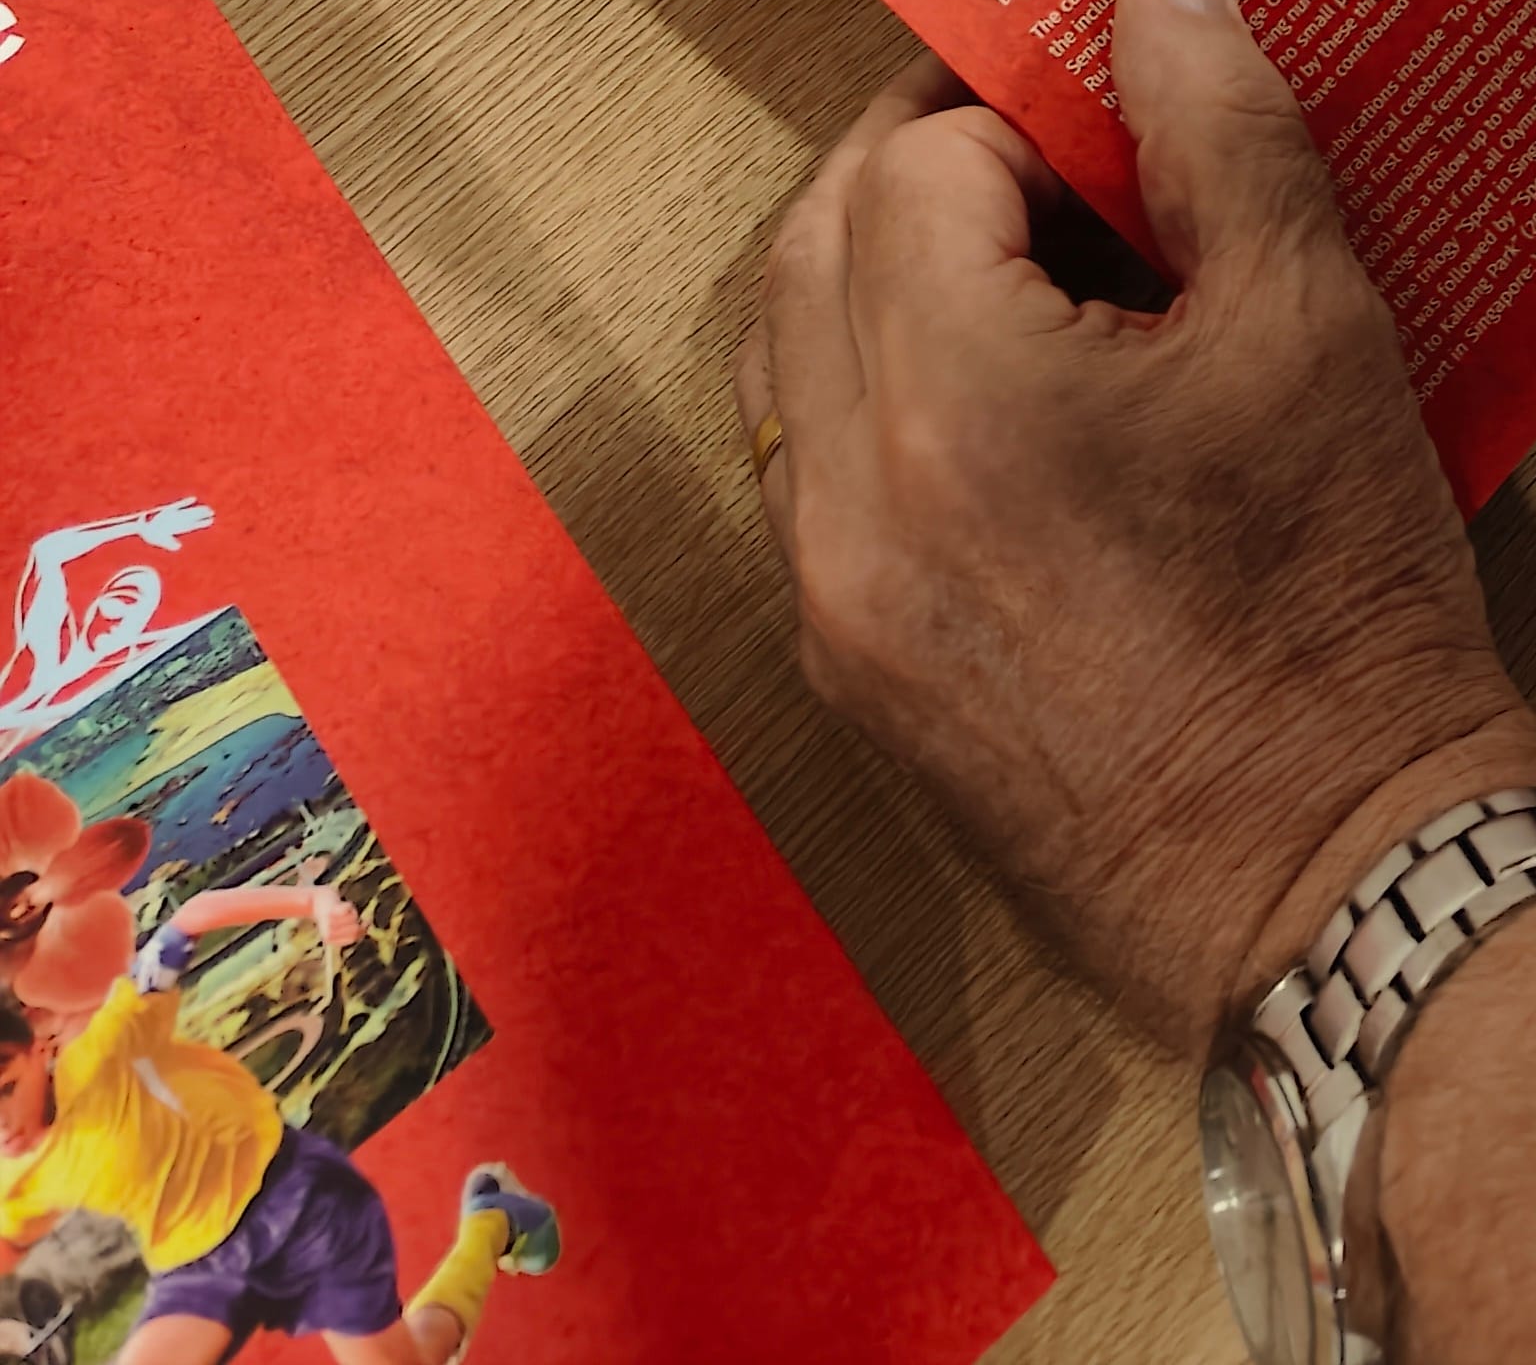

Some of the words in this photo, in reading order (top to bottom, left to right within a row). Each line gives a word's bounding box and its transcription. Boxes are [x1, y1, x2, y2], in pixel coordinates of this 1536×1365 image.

[1027, 9, 1063, 41] The
[1275, 45, 1299, 69] no
[1295, 2, 1338, 49] small
[1298, 75, 1338, 113] have
[1346, 182, 1374, 211] the
[1368, 151, 1404, 185] first
[1396, 113, 1436, 155] three
[1430, 64, 1479, 116] female
[1407, 359, 1456, 408] Sport
[1449, 341, 1470, 362] in
